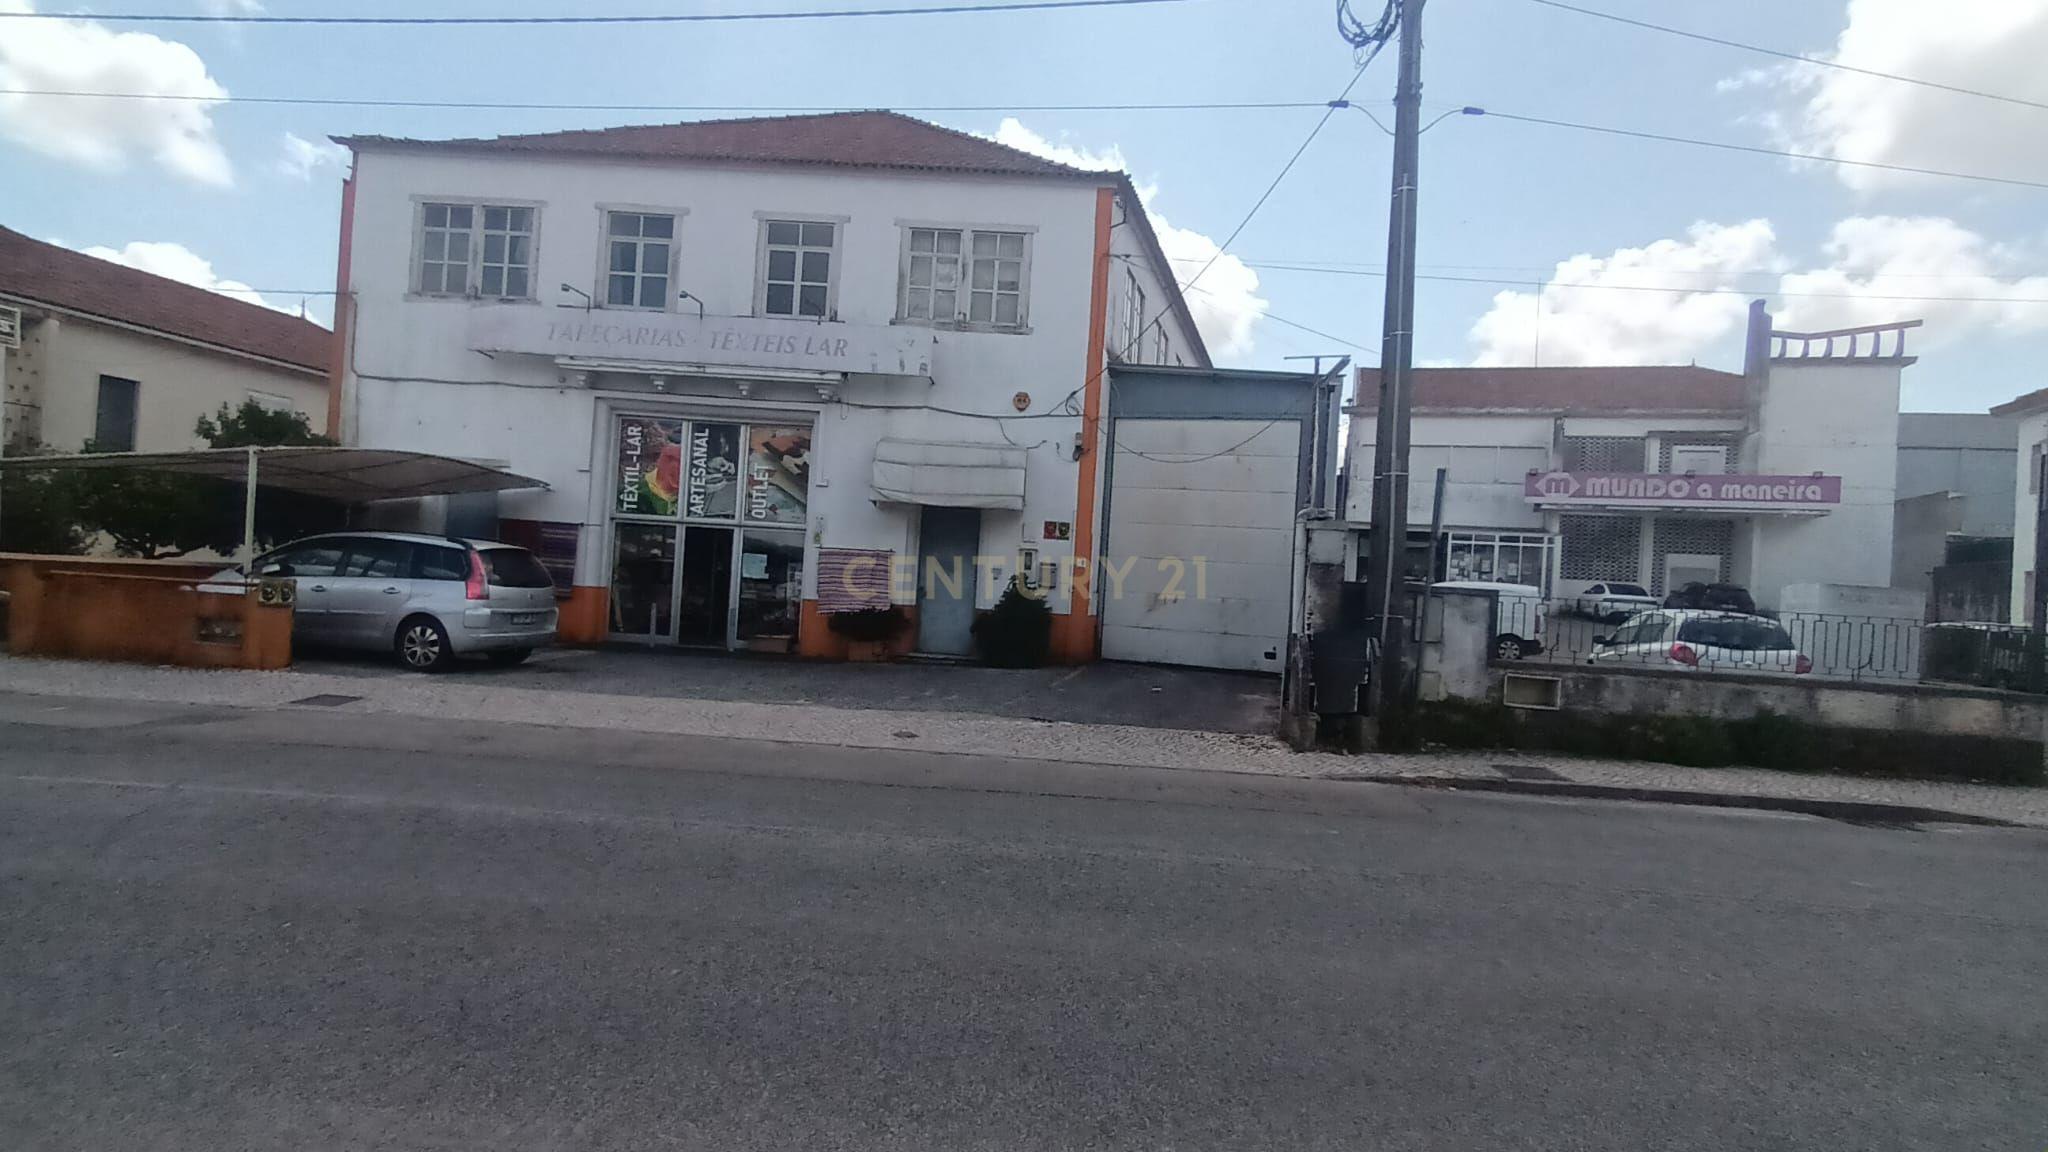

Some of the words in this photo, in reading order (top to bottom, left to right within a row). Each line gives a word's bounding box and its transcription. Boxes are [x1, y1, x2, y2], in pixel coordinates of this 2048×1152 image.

[804, 335, 849, 357] LAR
[620, 425, 643, 511] TÊXTIL-LAR
[689, 427, 709, 517] ARTESANAL
[751, 462, 770, 520] OUTLET
[1720, 478, 1823, 501] maneira
